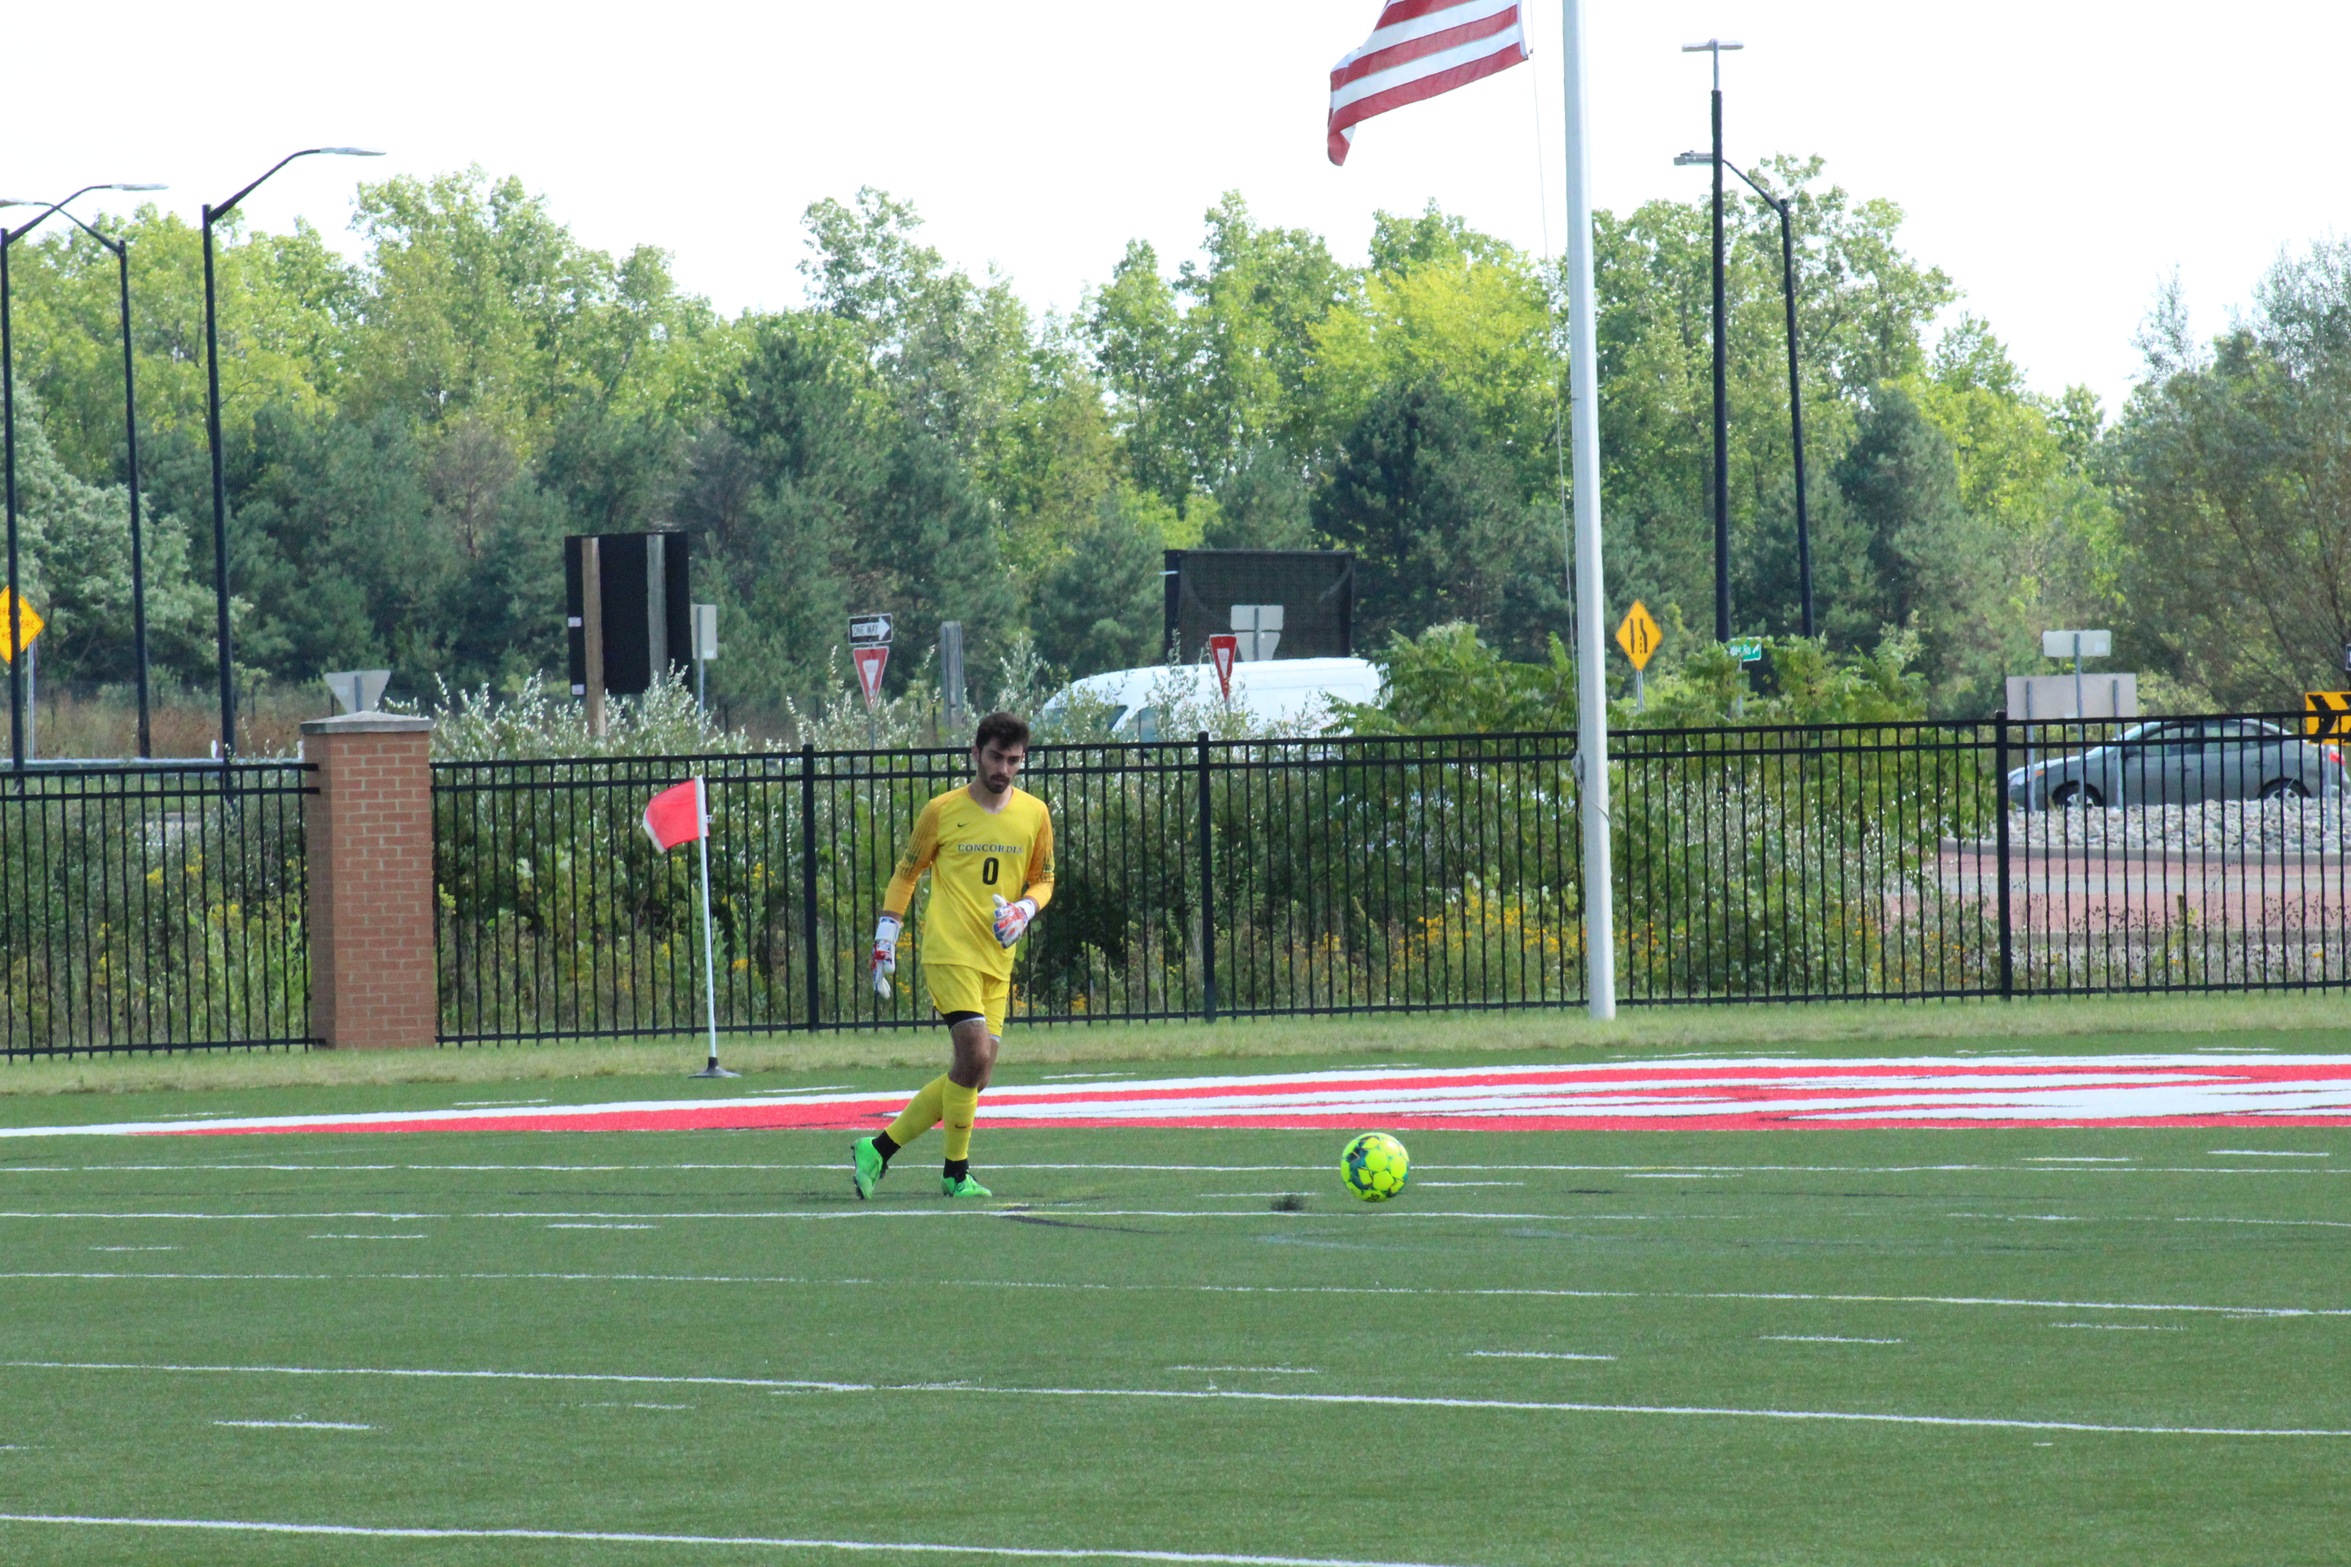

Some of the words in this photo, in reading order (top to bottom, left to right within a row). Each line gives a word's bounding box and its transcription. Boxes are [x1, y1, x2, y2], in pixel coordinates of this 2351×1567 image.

[854, 625, 865, 636] ONE
[867, 624, 879, 635] WAY
[958, 844, 1023, 854] CONCORDIA
[982, 857, 999, 885] 0
